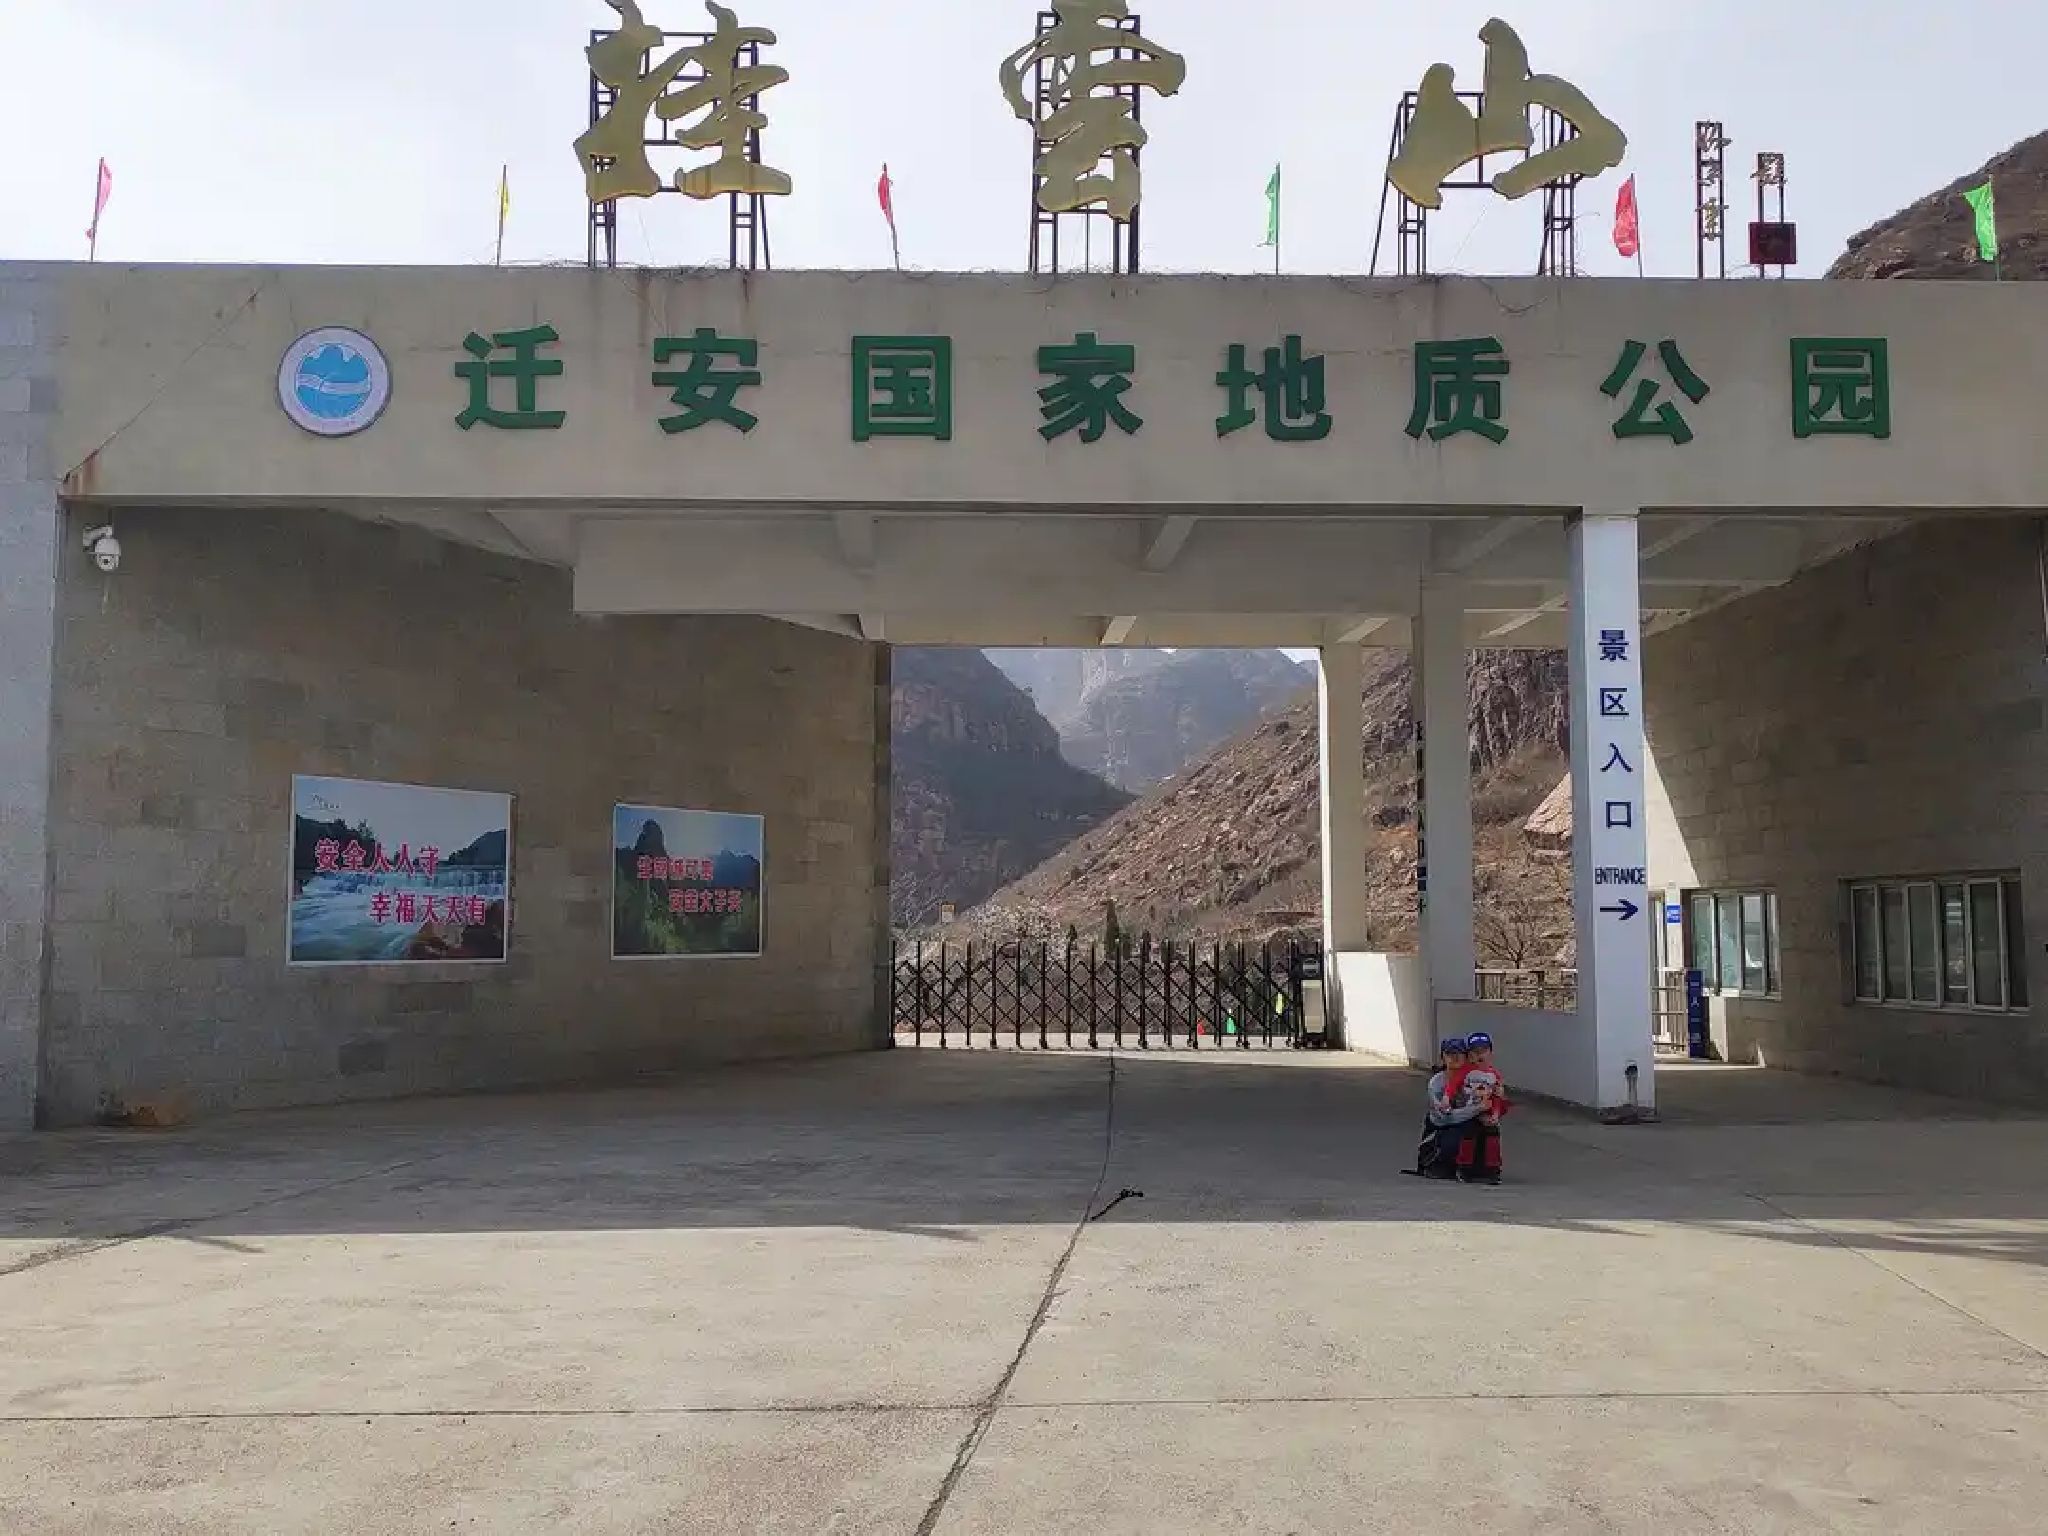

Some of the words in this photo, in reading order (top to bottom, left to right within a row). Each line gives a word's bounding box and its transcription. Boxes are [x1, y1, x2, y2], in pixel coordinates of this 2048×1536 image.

[454, 326, 1891, 444] 迁安国家地质公园
[1597, 629, 1633, 829] 景区入口
[315, 837, 440, 880] 安全人人守
[1594, 866, 1647, 885] ENTRANCE
[370, 892, 486, 926] 幸福天天有
